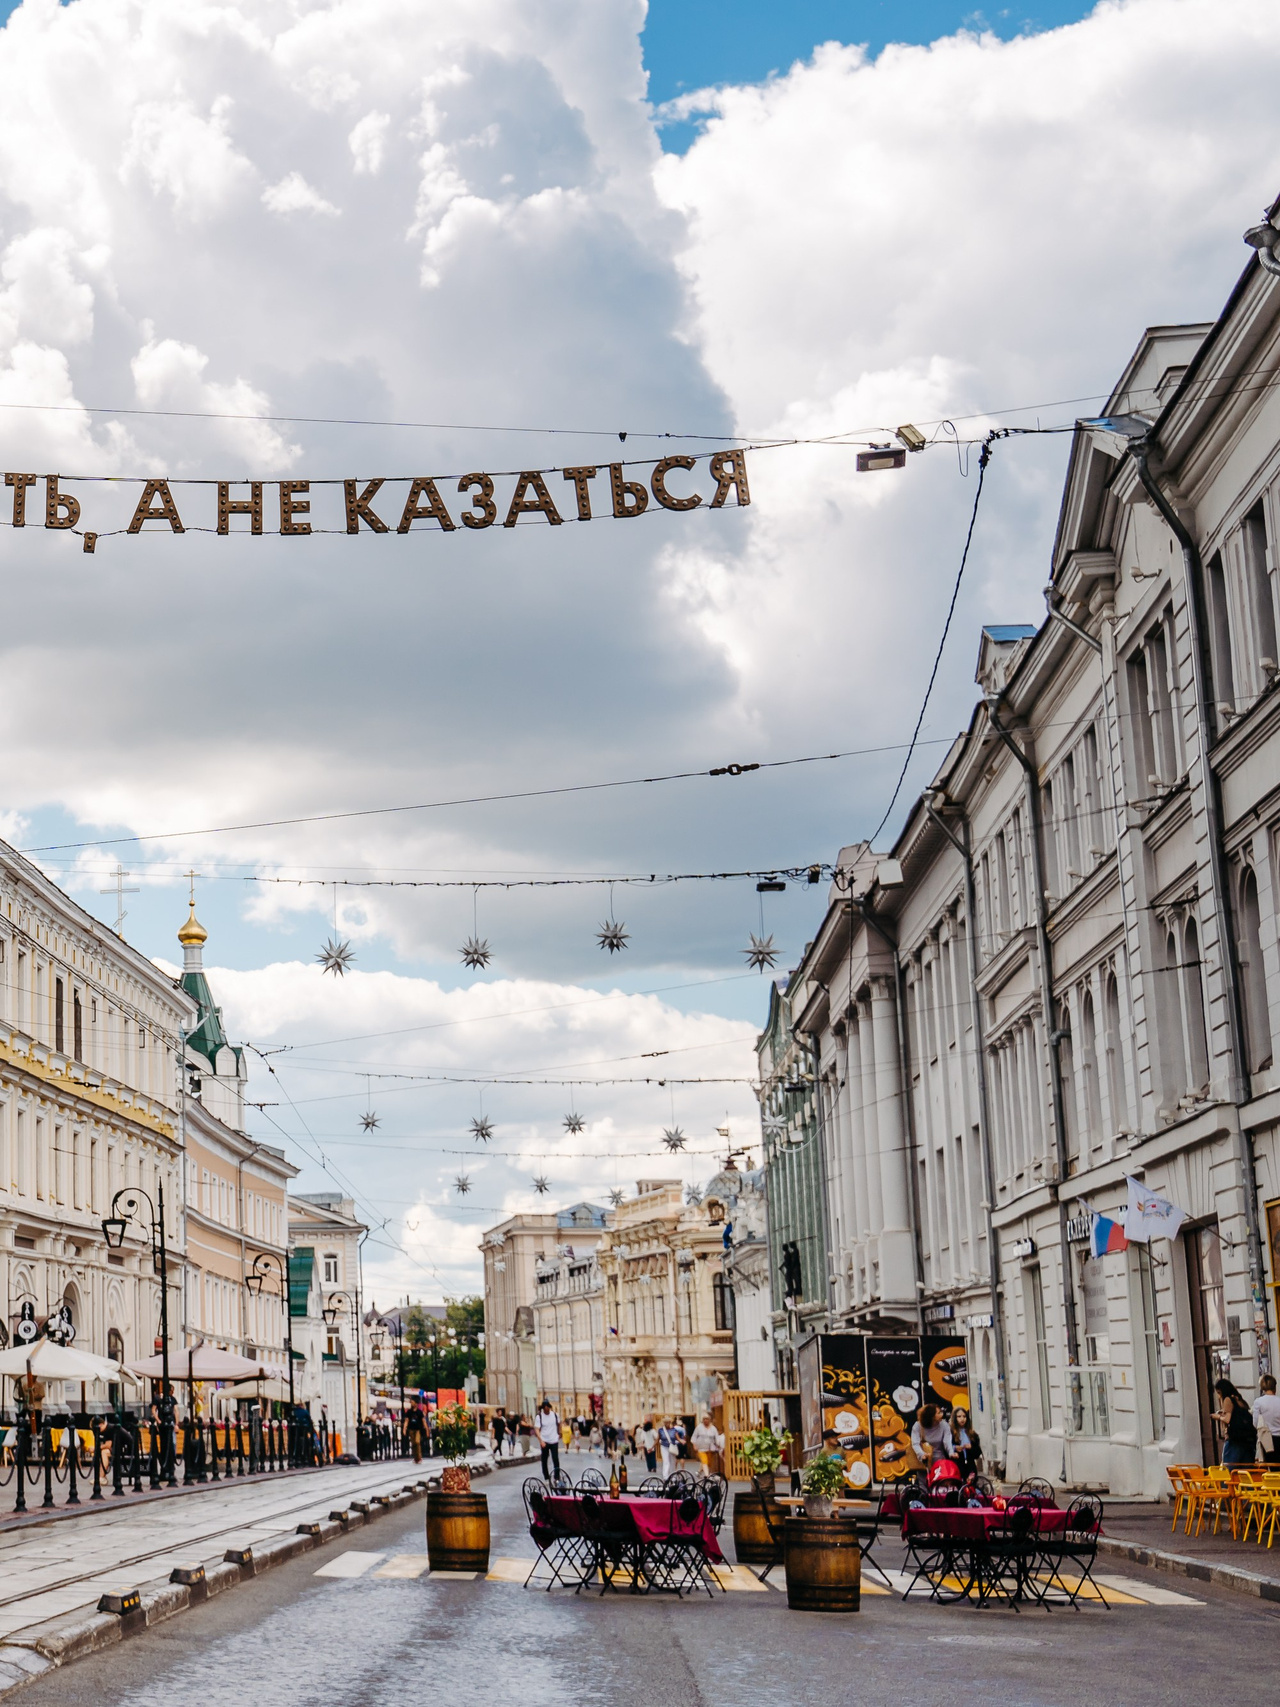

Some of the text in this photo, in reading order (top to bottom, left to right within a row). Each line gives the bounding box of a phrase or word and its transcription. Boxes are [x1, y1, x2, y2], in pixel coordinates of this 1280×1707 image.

[127, 478, 185, 534] А
[217, 479, 312, 535] НЕ
[343, 449, 751, 535] КАЗАТЬСЯ
